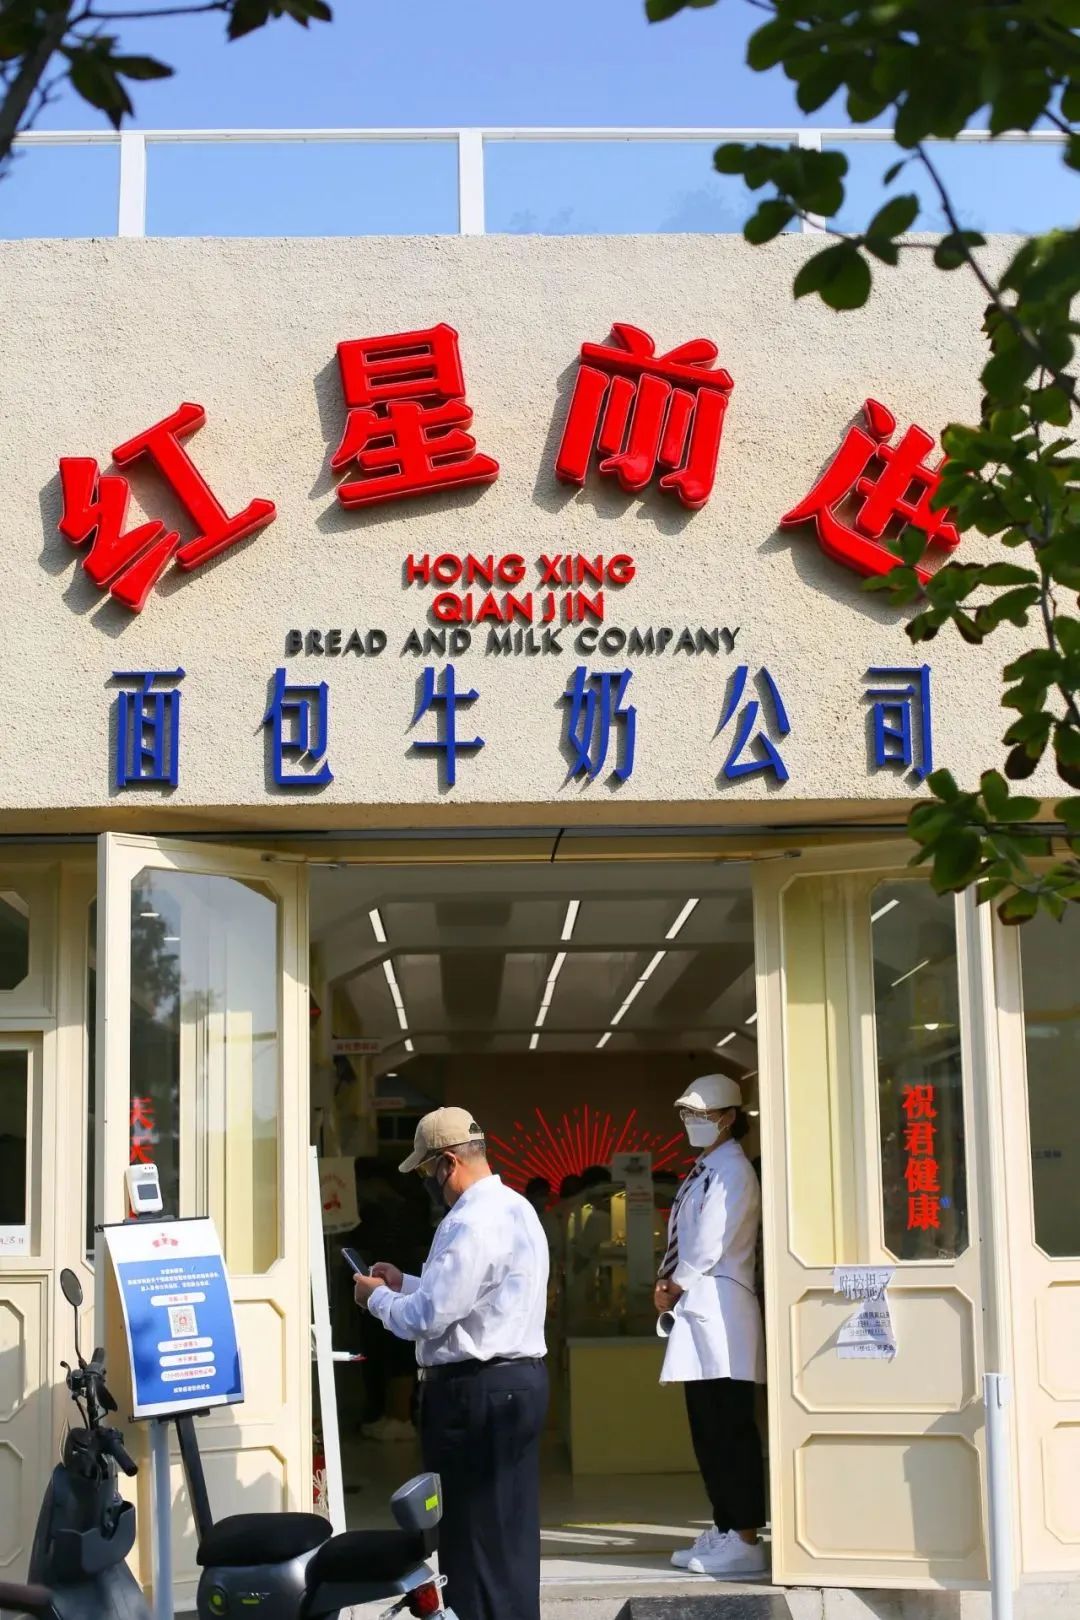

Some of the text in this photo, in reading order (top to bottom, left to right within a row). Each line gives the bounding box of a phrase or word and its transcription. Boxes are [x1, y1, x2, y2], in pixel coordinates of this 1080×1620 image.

[405, 553, 636, 584] HONG XING
[431, 591, 604, 623] QIAN JIN
[288, 626, 741, 655] BREAD AND MILK COMPANY
[112, 664, 933, 788] 面包牛奶公司
[902, 1084, 941, 1231] 祝君健康
